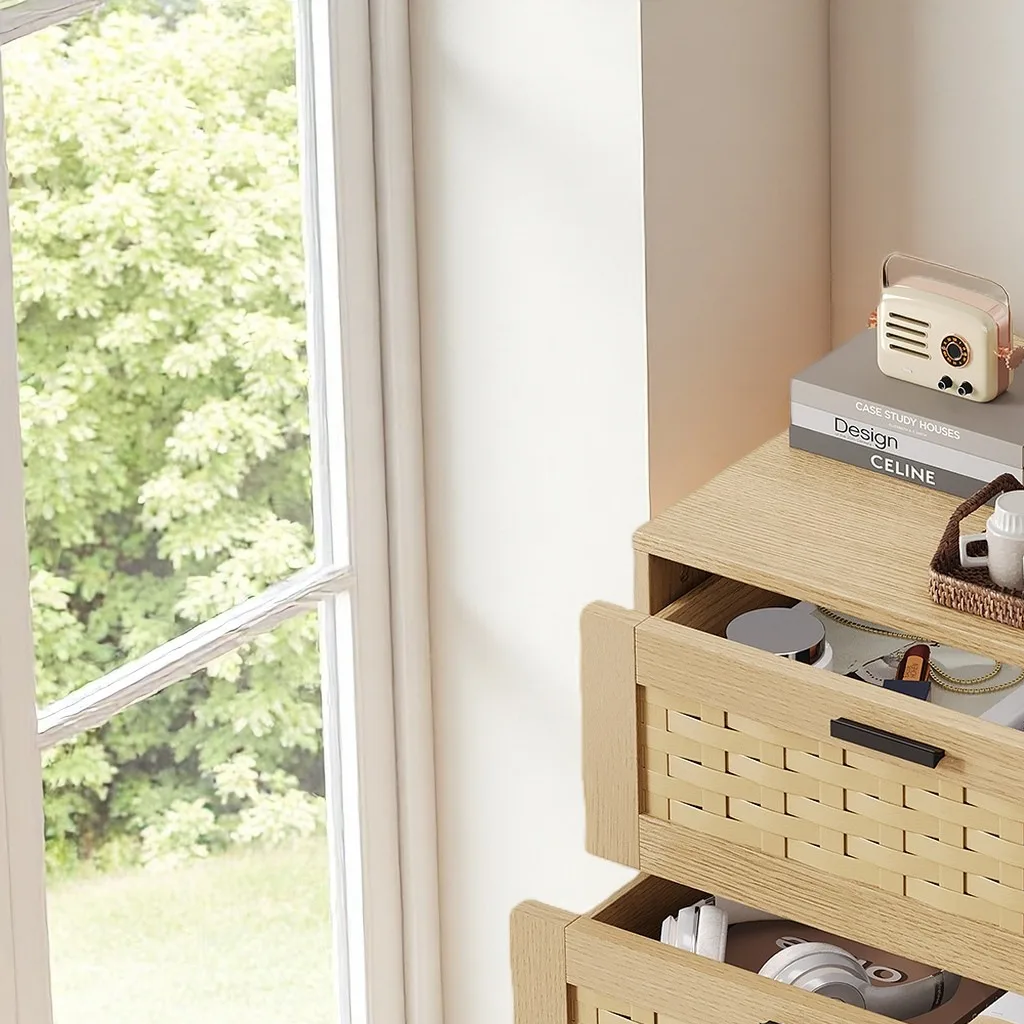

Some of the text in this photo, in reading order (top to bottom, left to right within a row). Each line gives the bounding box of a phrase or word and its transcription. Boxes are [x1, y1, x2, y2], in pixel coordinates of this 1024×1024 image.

[834, 416, 898, 450] Design
[855, 401, 882, 417] CASE
[884, 409, 917, 427] STUDY
[919, 420, 960, 440] HOUSES
[870, 454, 936, 485] CELINE
